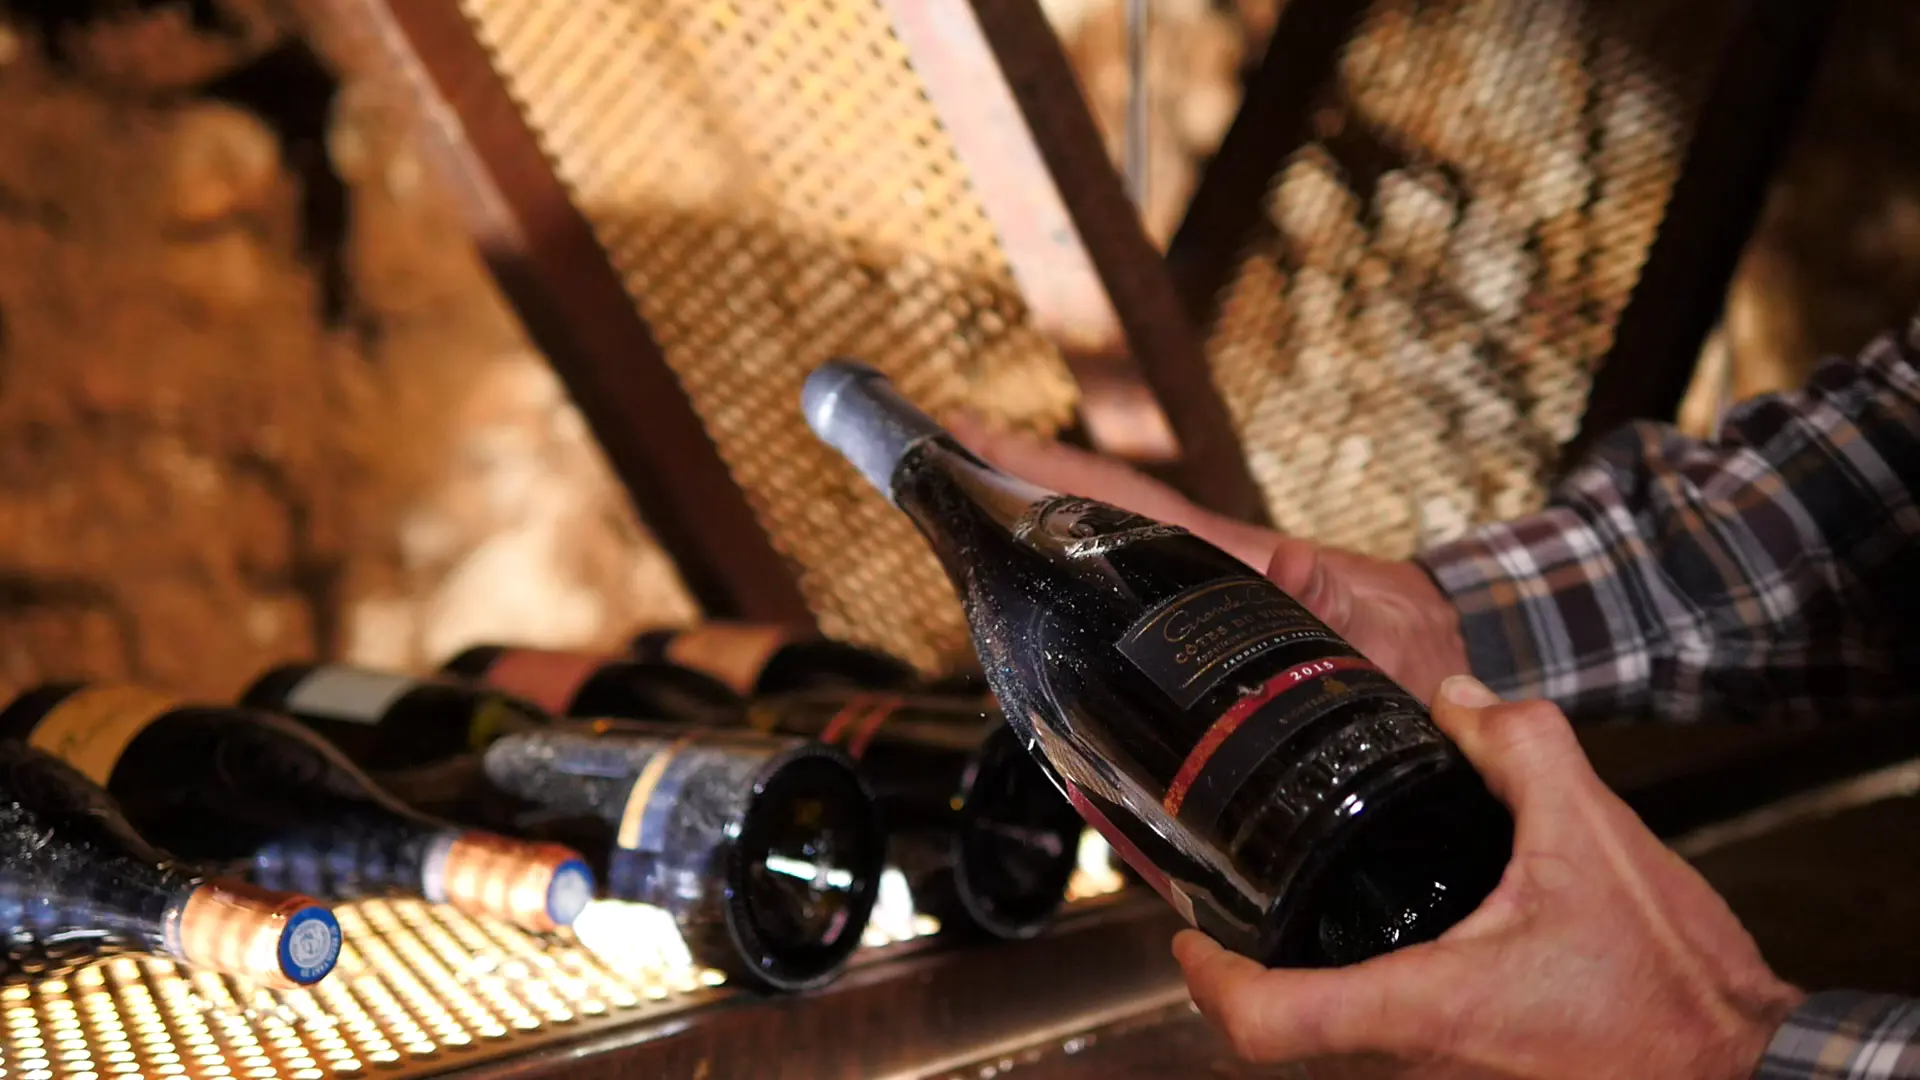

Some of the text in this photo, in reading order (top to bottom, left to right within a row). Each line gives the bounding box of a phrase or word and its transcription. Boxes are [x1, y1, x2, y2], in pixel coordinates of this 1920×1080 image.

[1231, 614, 1256, 629] DU
[1223, 641, 1269, 669] PRODUIT
[1274, 635, 1288, 643] DE
[1289, 661, 1334, 681] 2015
